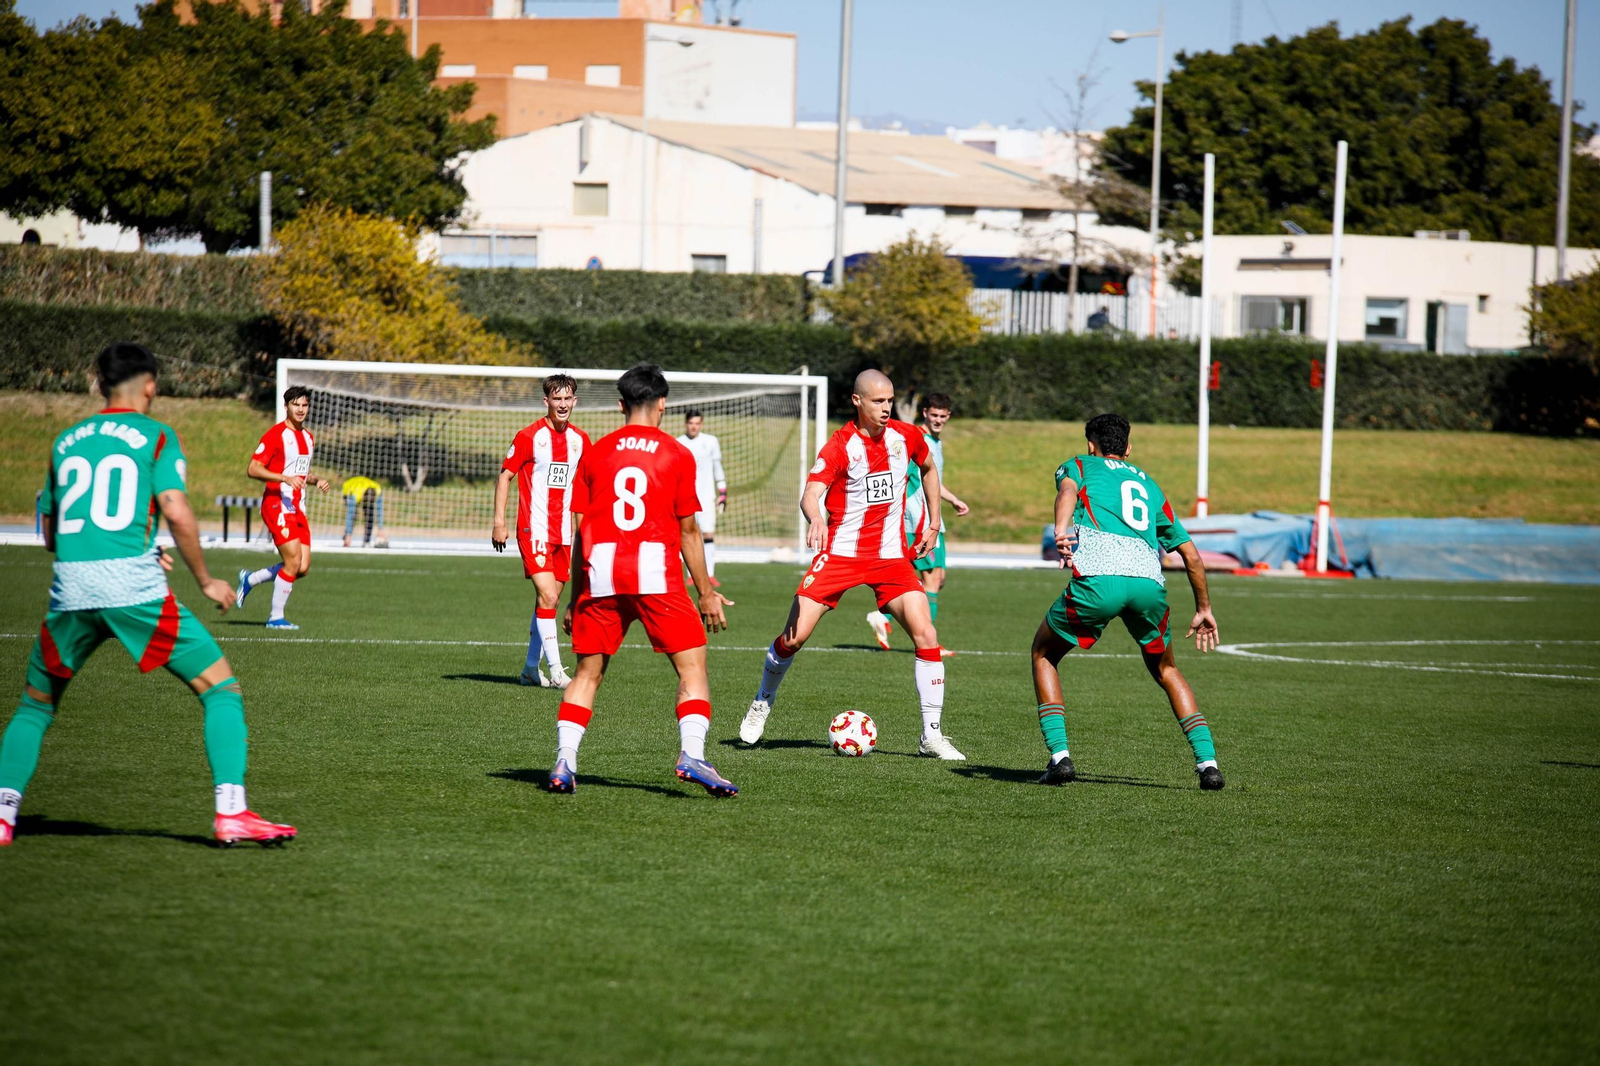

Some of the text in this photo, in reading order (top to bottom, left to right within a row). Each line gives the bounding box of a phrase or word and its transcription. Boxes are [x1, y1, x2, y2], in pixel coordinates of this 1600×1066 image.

[616, 436, 659, 454] JOAN
[872, 478, 889, 489] DA
[58, 453, 139, 535] 20
[612, 466, 648, 532] 8
[873, 489, 888, 498] ZN
[1120, 479, 1150, 532] 6
[277, 511, 286, 528] 4
[530, 538, 547, 555] 14
[812, 553, 829, 573] 6
